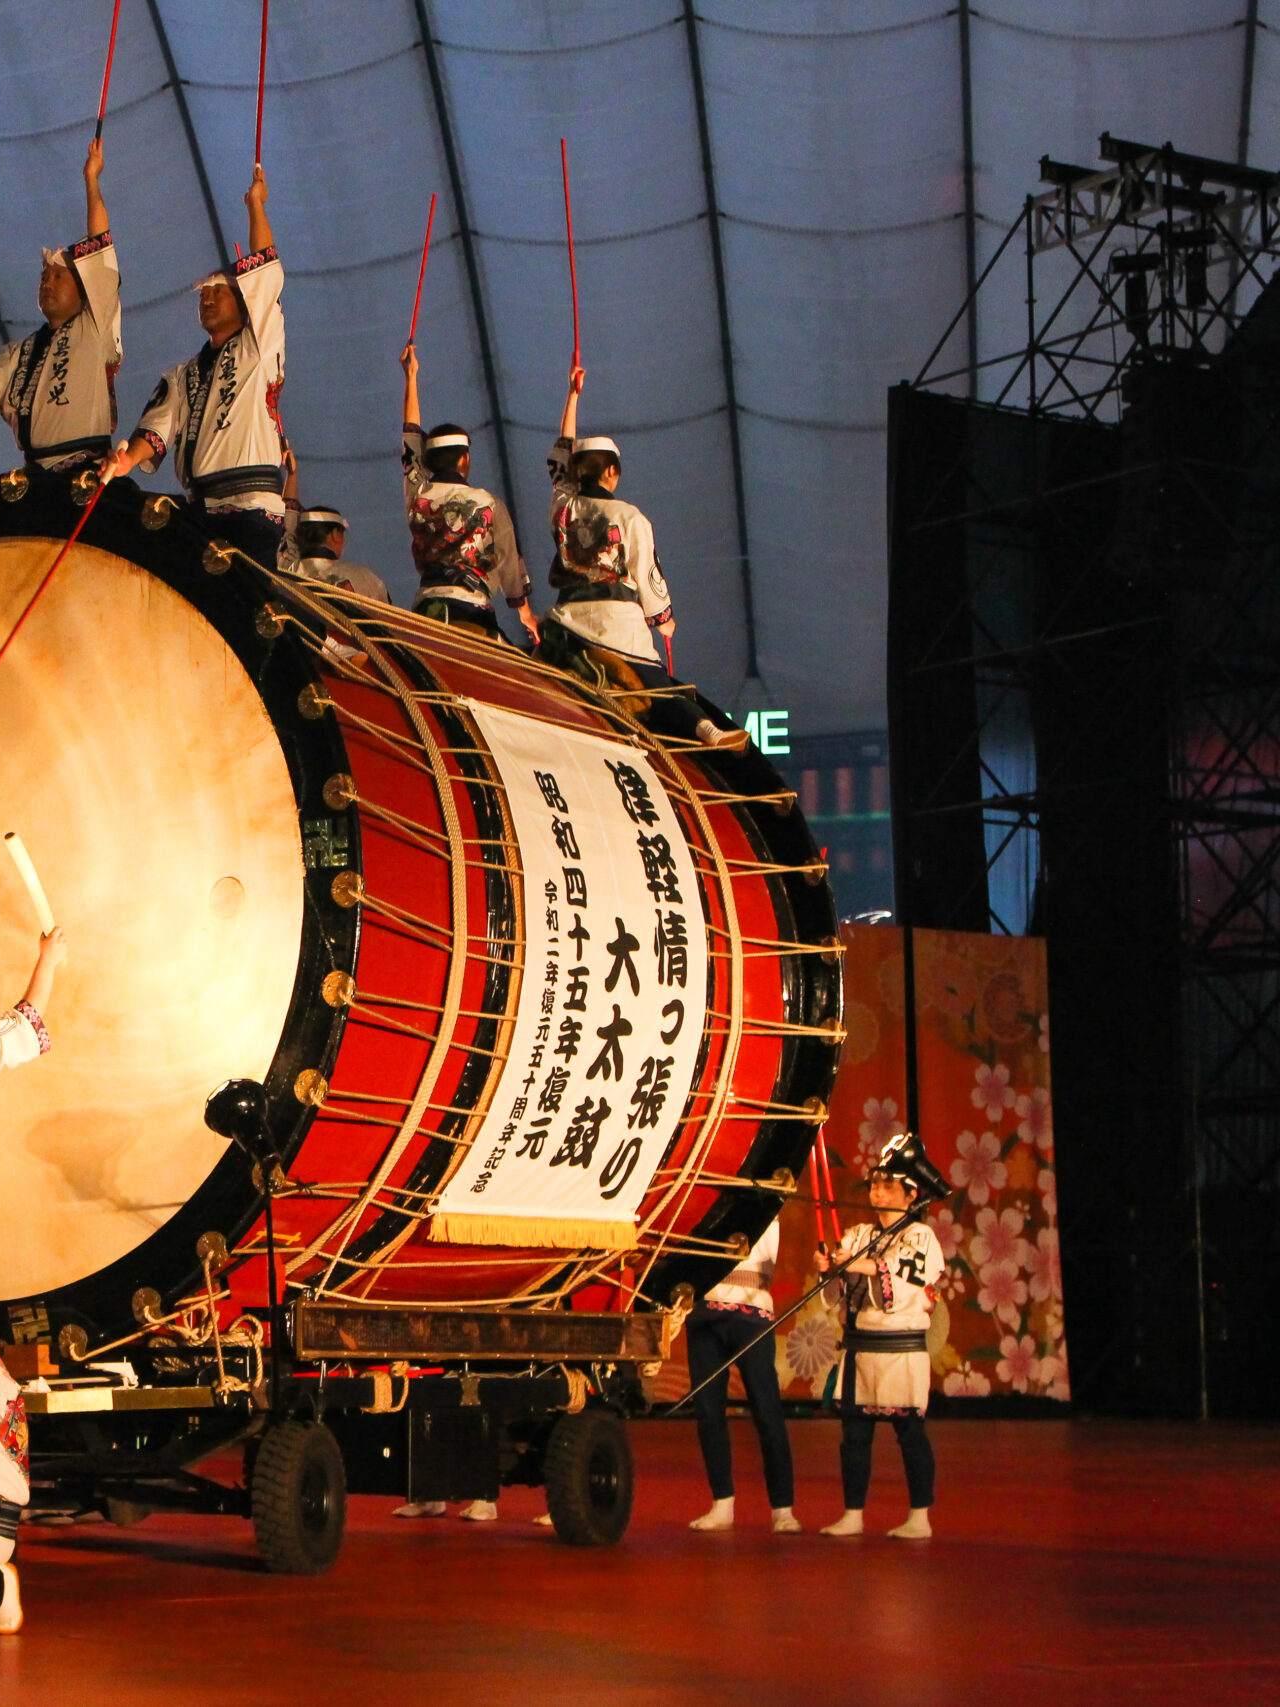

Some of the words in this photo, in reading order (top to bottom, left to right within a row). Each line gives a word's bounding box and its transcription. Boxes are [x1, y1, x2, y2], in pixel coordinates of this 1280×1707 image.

[515, 769, 591, 1160] 昭和四十五年復元
[549, 916, 641, 1169] 大太鼓
